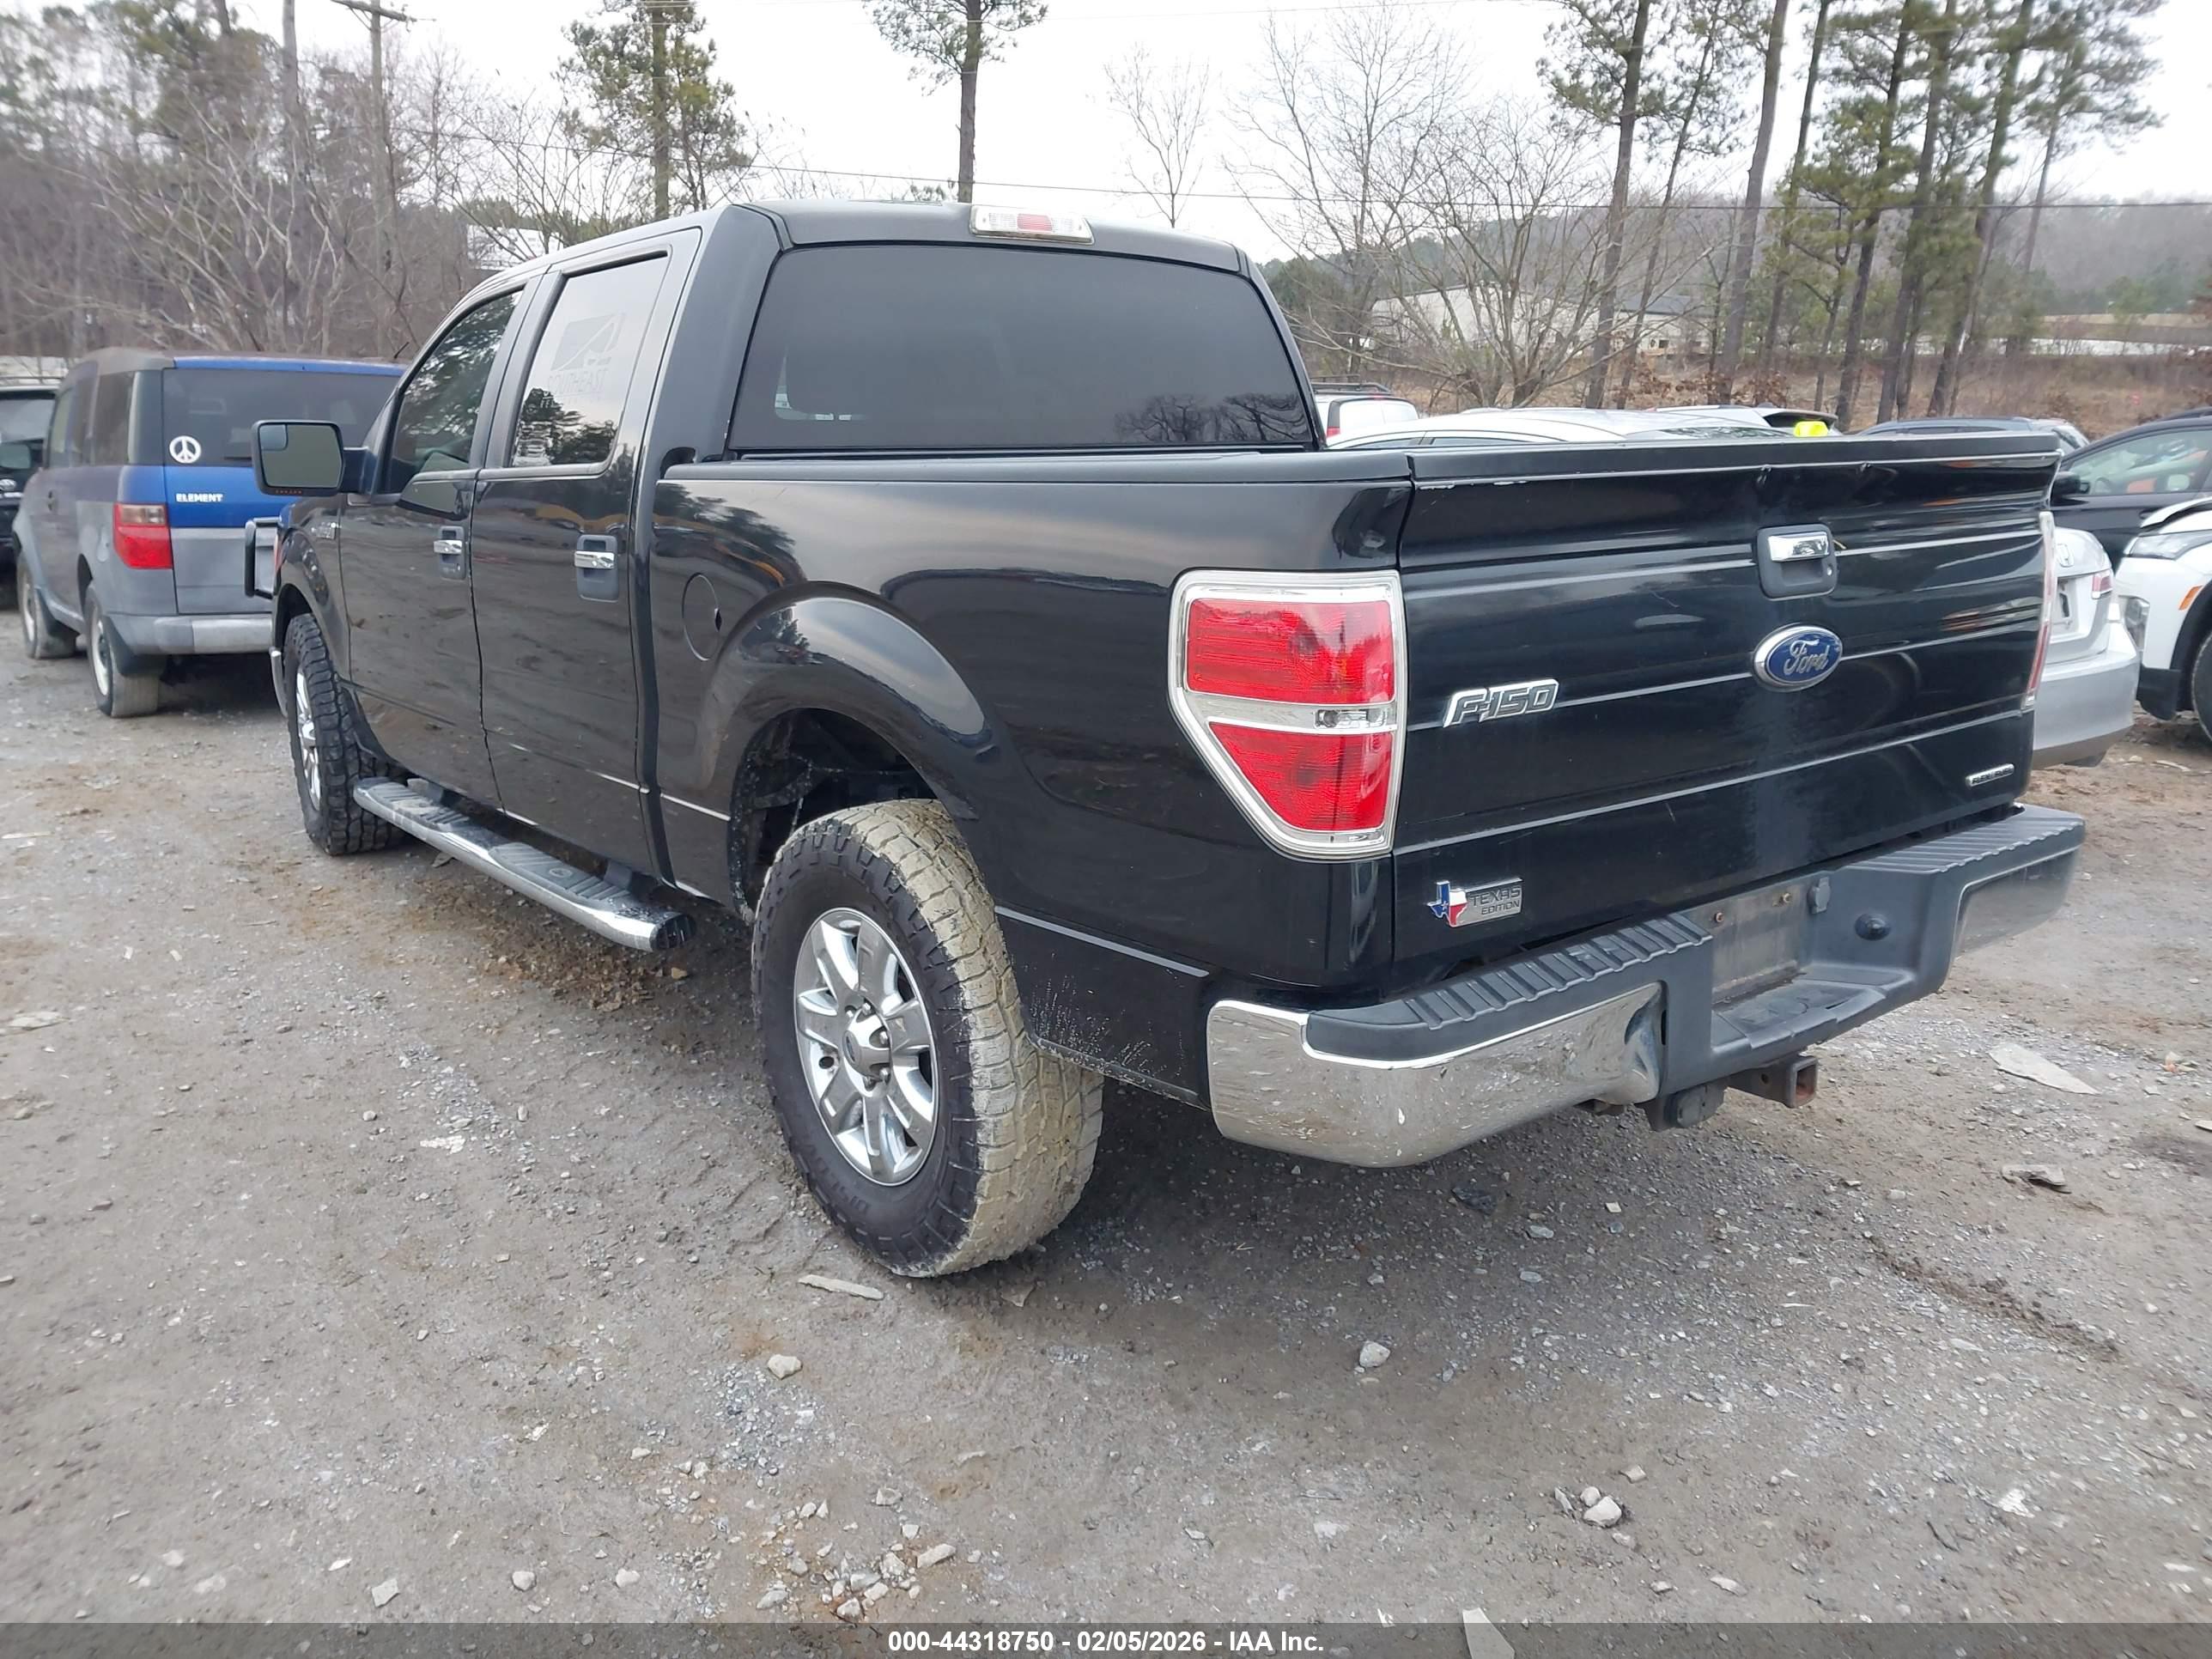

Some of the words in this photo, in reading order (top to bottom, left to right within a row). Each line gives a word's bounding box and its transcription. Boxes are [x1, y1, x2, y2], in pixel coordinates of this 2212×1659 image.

[176, 493, 224, 503] ELEMENT
[1784, 638, 1830, 677] Ford
[1443, 678, 1559, 728] F-150
[1470, 885, 1522, 907] TEXAS
[1481, 900, 1520, 915] EDITION
